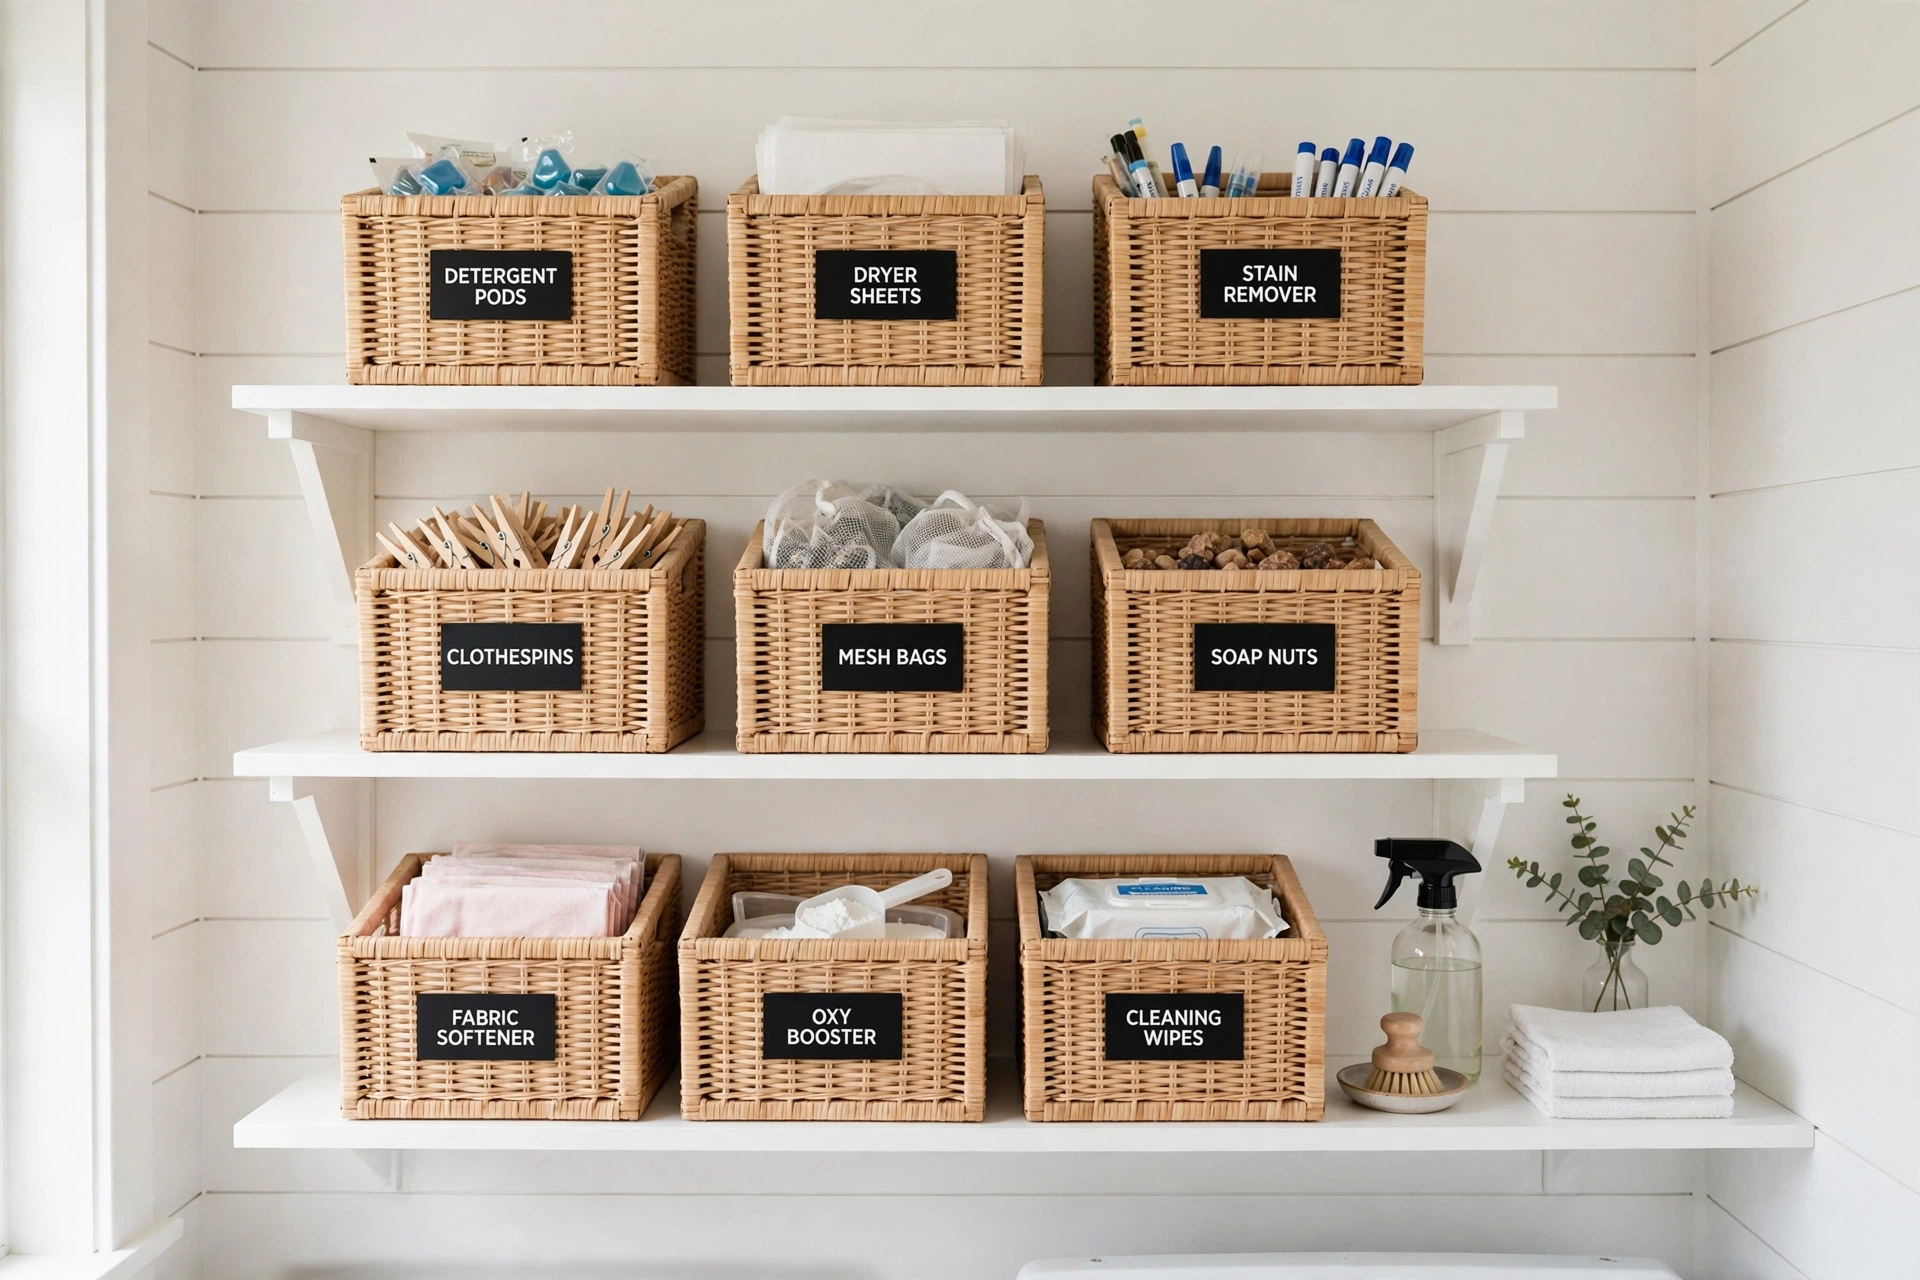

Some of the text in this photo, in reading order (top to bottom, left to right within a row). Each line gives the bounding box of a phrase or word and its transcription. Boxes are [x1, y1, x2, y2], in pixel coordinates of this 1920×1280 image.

[444, 267, 558, 285] DETERGENT
[854, 266, 918, 284] DRYER
[1242, 264, 1298, 282] STAIN
[475, 288, 527, 306] PODS
[850, 287, 922, 305] SHEETS
[1224, 285, 1317, 303] REMOVER
[446, 648, 574, 666] CLOTHESPINS
[838, 648, 947, 666] MESH BAGS
[1211, 648, 1318, 666] SOAP NUTS
[452, 1009, 519, 1026] FABRIC
[811, 1008, 852, 1025] OXY
[1126, 1009, 1222, 1026] CLEANING
[436, 1029, 535, 1046] SOFTENER
[787, 1028, 877, 1046] BOOSTER
[1143, 1029, 1204, 1047] WIPES
